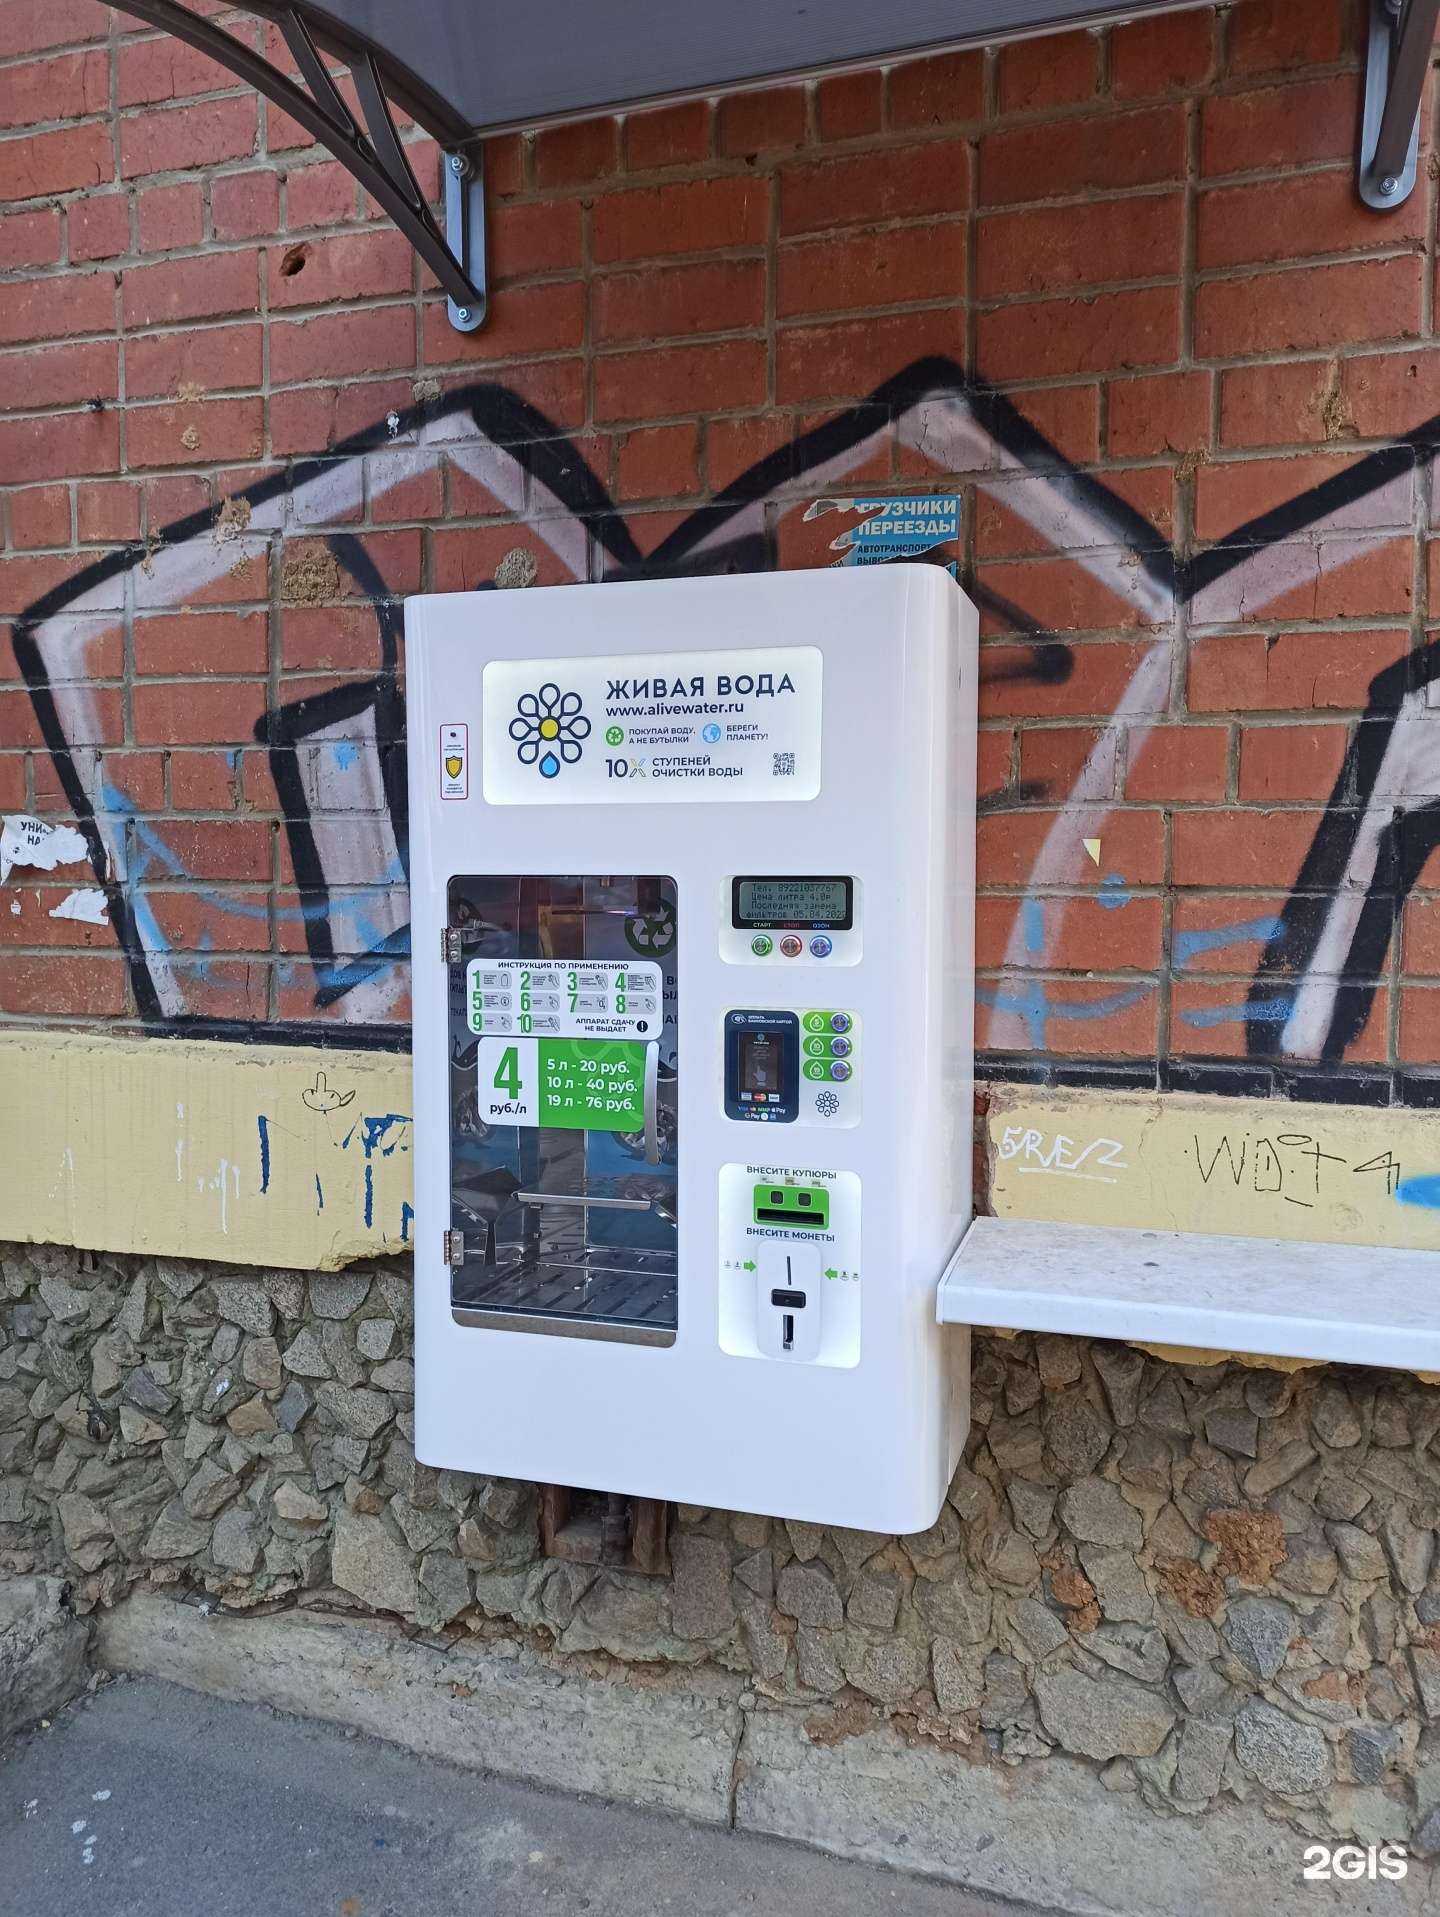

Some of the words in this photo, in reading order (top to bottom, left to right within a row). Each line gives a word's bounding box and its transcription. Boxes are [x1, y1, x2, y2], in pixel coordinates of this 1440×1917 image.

[857, 519, 956, 536] ПЕРЕЕЗДЫ
[606, 676, 705, 700] ЖИВАЯ
[717, 672, 796, 698] ВОДА
[605, 701, 745, 717] www.alivewater.ru
[628, 726, 669, 736] ПОКУПАЙ
[726, 724, 759, 732] БЕРЕГИ
[649, 736, 689, 744] БУТЫЛКИ
[726, 733, 769, 741] ПЛАНЕТУ!
[652, 754, 711, 767] СТУПЕНЕЙ
[652, 767, 705, 778] ОЧИСТКИ
[708, 767, 743, 777] ВОДЫ
[20, 821, 49, 835] УНИ
[498, 961, 552, 970] ИНСТРУКЦИЯ
[554, 962, 567, 970] ПО
[568, 962, 629, 971] ПРИМЕНЕНИЮ
[472, 970, 480, 989] 1
[520, 971, 531, 990] 2
[567, 971, 578, 991] 3
[615, 972, 627, 992] 4
[472, 991, 483, 1010] 5
[520, 992, 531, 1012] 6
[567, 993, 578, 1013] 7
[615, 994, 626, 1014] 8
[472, 1012, 483, 1032] 9
[516, 1013, 532, 1033] 10
[575, 1018, 610, 1026] АППАРАТ
[611, 1018, 636, 1027] СДАЧУ
[493, 1046, 523, 1100] 4
[546, 1058, 556, 1070] 5
[559, 1061, 568, 1071] л
[580, 1059, 597, 1072] 20
[600, 1061, 630, 1075] руб.
[546, 1076, 562, 1088] 10
[564, 1079, 574, 1089] л
[586, 1078, 605, 1090] 40
[608, 1079, 638, 1094] руб.
[489, 1102, 527, 1115] руб./л
[546, 1094, 561, 1107] 19
[564, 1097, 574, 1107] л
[585, 1096, 603, 1108] 76
[606, 1098, 636, 1112] руб.
[746, 1165, 790, 1176] ВНЕСИТЕ
[792, 1169, 837, 1179] КУПЮРЫ
[746, 1227, 790, 1239] ВНЕСИТЕ
[792, 1231, 835, 1243] МОНЕТЫ
